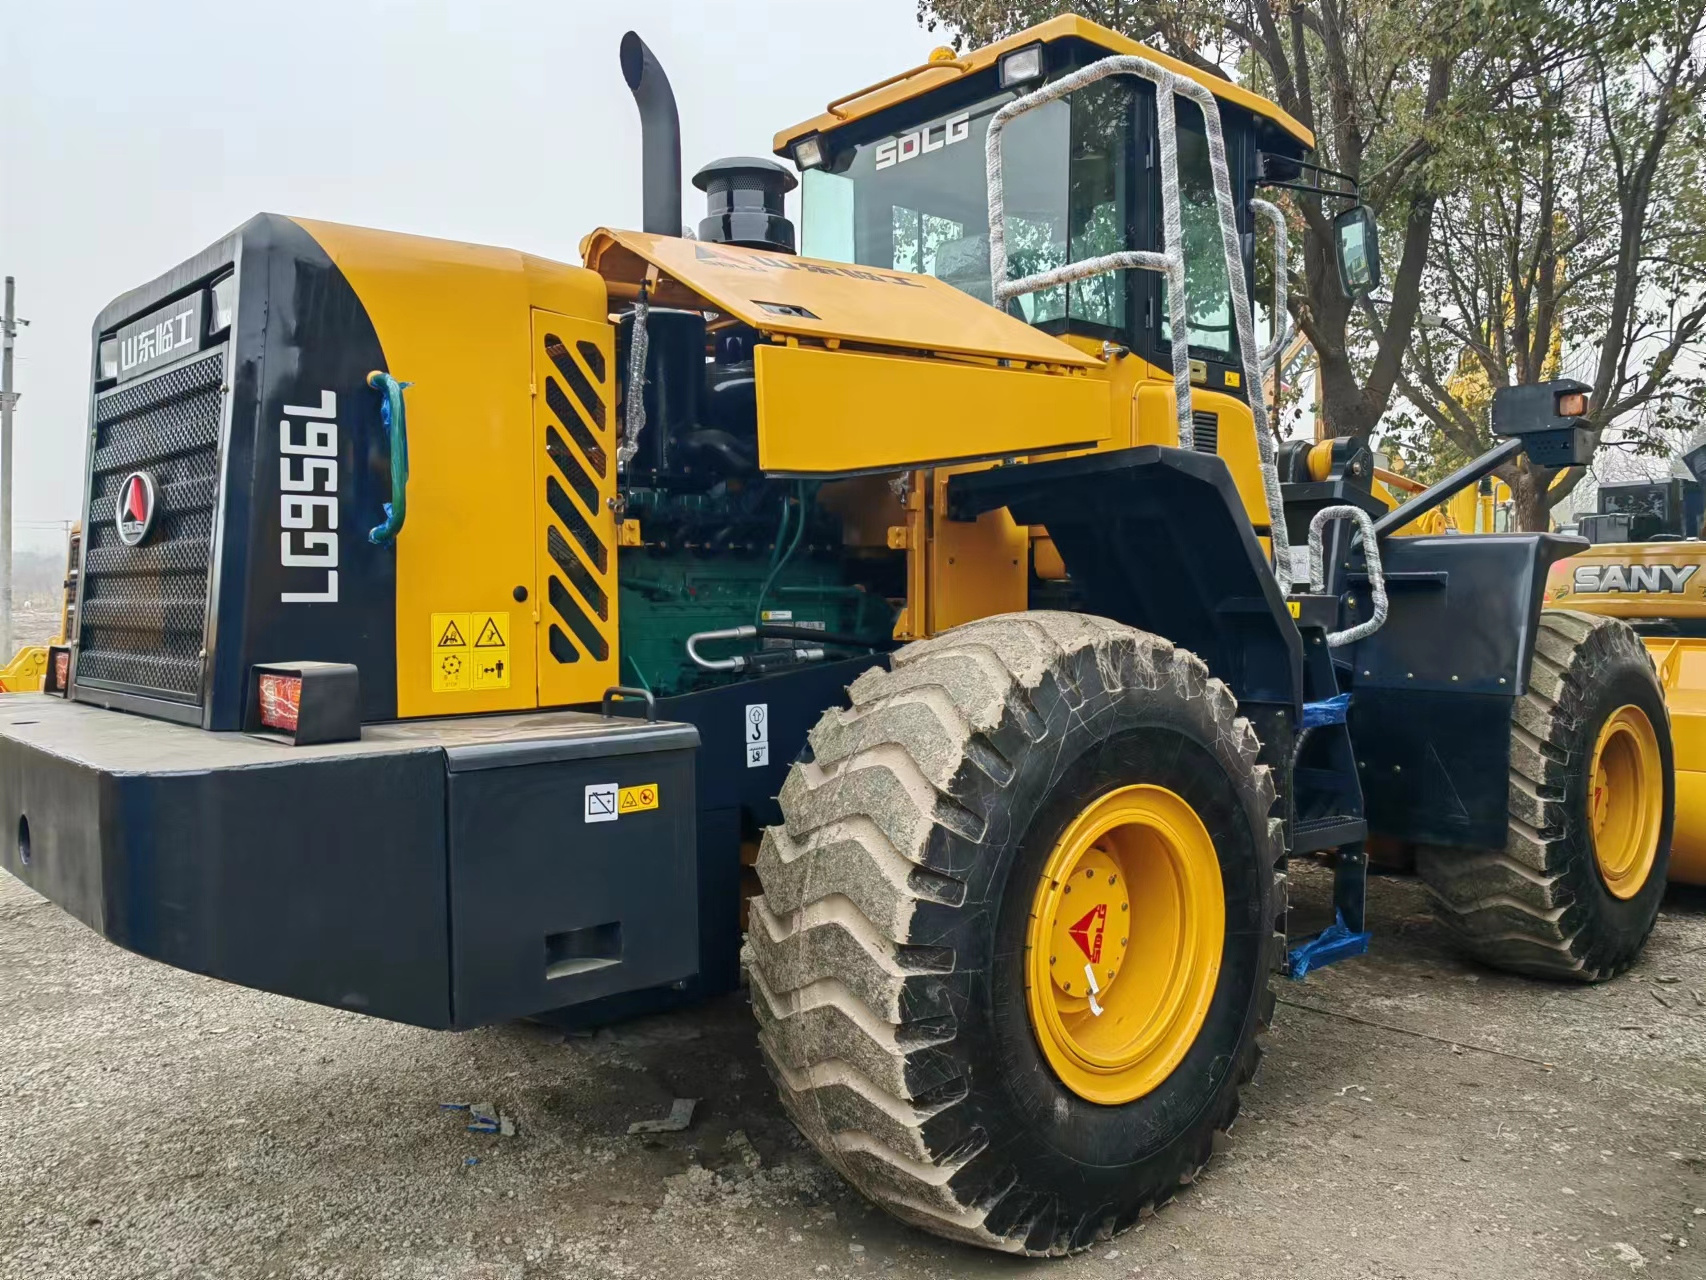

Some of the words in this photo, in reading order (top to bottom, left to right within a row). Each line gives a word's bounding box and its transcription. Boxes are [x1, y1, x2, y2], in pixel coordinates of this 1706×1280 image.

[876, 112, 969, 170] SDLG
[121, 308, 193, 371] 山东临工
[279, 389, 339, 603] LG956L
[1573, 563, 1700, 593] SANY
[1091, 903, 1108, 964] SDLG
